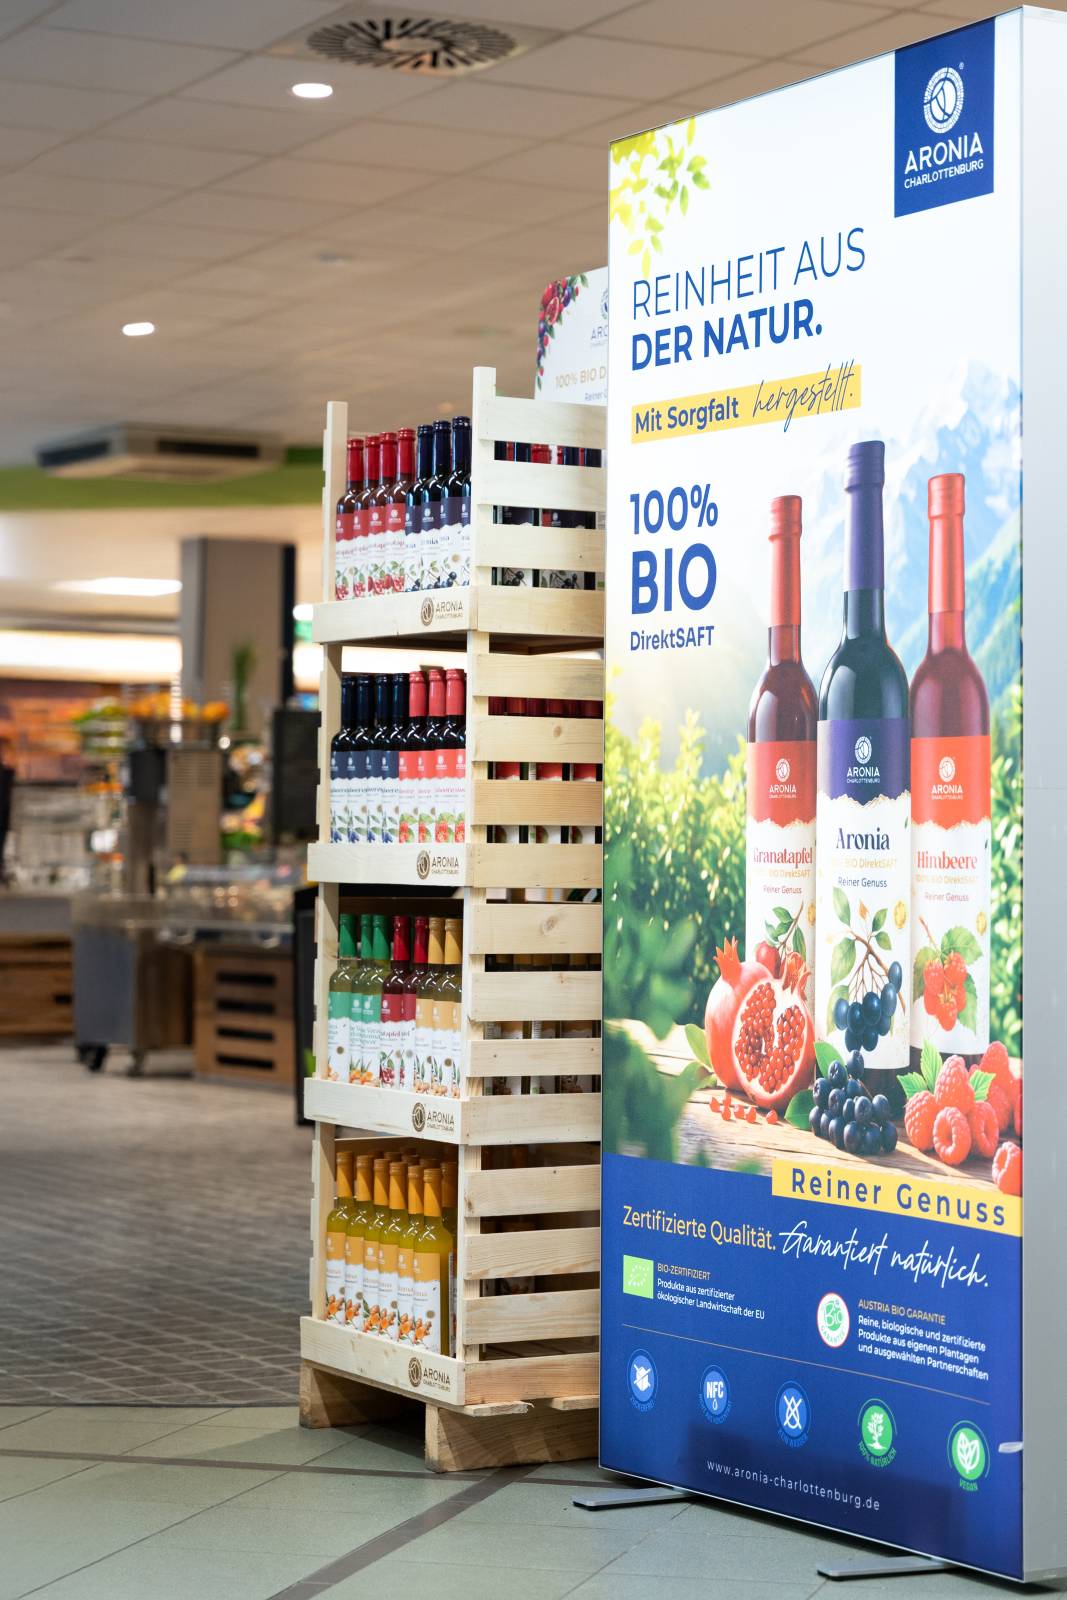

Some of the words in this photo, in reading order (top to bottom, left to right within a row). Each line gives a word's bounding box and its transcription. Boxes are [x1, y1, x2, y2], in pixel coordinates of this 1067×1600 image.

[904, 132, 984, 175] ARONIA
[904, 159, 984, 189] CHARLOTTENBURG
[632, 245, 787, 321] REINHEIT
[793, 227, 866, 285] AUS
[631, 323, 693, 371] DER
[703, 298, 823, 358] NATUR.
[580, 369, 597, 384] BIO
[635, 407, 662, 435] Mit
[667, 396, 740, 430] Sorgfalt
[752, 359, 855, 433] hergestellt.
[629, 483, 719, 535] 100%
[630, 543, 718, 615] BIO
[435, 600, 464, 613] ARONIA
[629, 625, 715, 652] DirektSAFT
[846, 766, 880, 777] ARONIA
[769, 784, 797, 793] ARONIA
[931, 784, 964, 794] ARONIA
[836, 827, 890, 850] Aronia
[431, 856, 460, 868] ARONIA
[753, 847, 813, 869] Granatapfel
[917, 851, 978, 869] Himbeere
[838, 876, 860, 887] Reiner
[861, 877, 888, 888] Genuss
[427, 1110, 455, 1126] ARONIA
[791, 1167, 882, 1204] Reiner
[896, 1183, 1005, 1227] Genuss
[623, 1205, 707, 1239] Zertifizierte
[710, 1220, 776, 1251] Qualität.
[779, 1220, 889, 1275] Garantiert
[890, 1240, 988, 1288] natürlich.
[657, 1263, 711, 1281] BIO-ZERTIFIZIERT
[657, 1278, 685, 1293] Produkte
[685, 1284, 697, 1294] aus
[697, 1287, 736, 1301] zertifizierter
[657, 1291, 699, 1307] ökologischer
[696, 1298, 742, 1316] Landwirtschaft
[743, 1307, 754, 1317] der
[755, 1309, 765, 1320] EU
[858, 1299, 890, 1313] AUSTRIA
[892, 1306, 905, 1316] BIO
[906, 1308, 946, 1326] GARANTIE
[858, 1315, 881, 1329] Reine,
[881, 1319, 924, 1338] biologische
[925, 1329, 941, 1341] und
[941, 1333, 986, 1352] zertifizierte
[858, 1329, 892, 1344] Produkte
[892, 1336, 906, 1347] aus
[907, 1338, 938, 1355] eigenen
[939, 1345, 979, 1364] Plantagen
[858, 1343, 873, 1353] und
[873, 1347, 926, 1365] ausgewählten
[927, 1356, 989, 1381] Partnerschaften
[423, 1367, 451, 1386] ARONIA
[706, 1381, 724, 1399] NFC
[707, 1460, 881, 1511] www.aronia-charlottenburg.de
[959, 1478, 979, 1492] VEGAN
